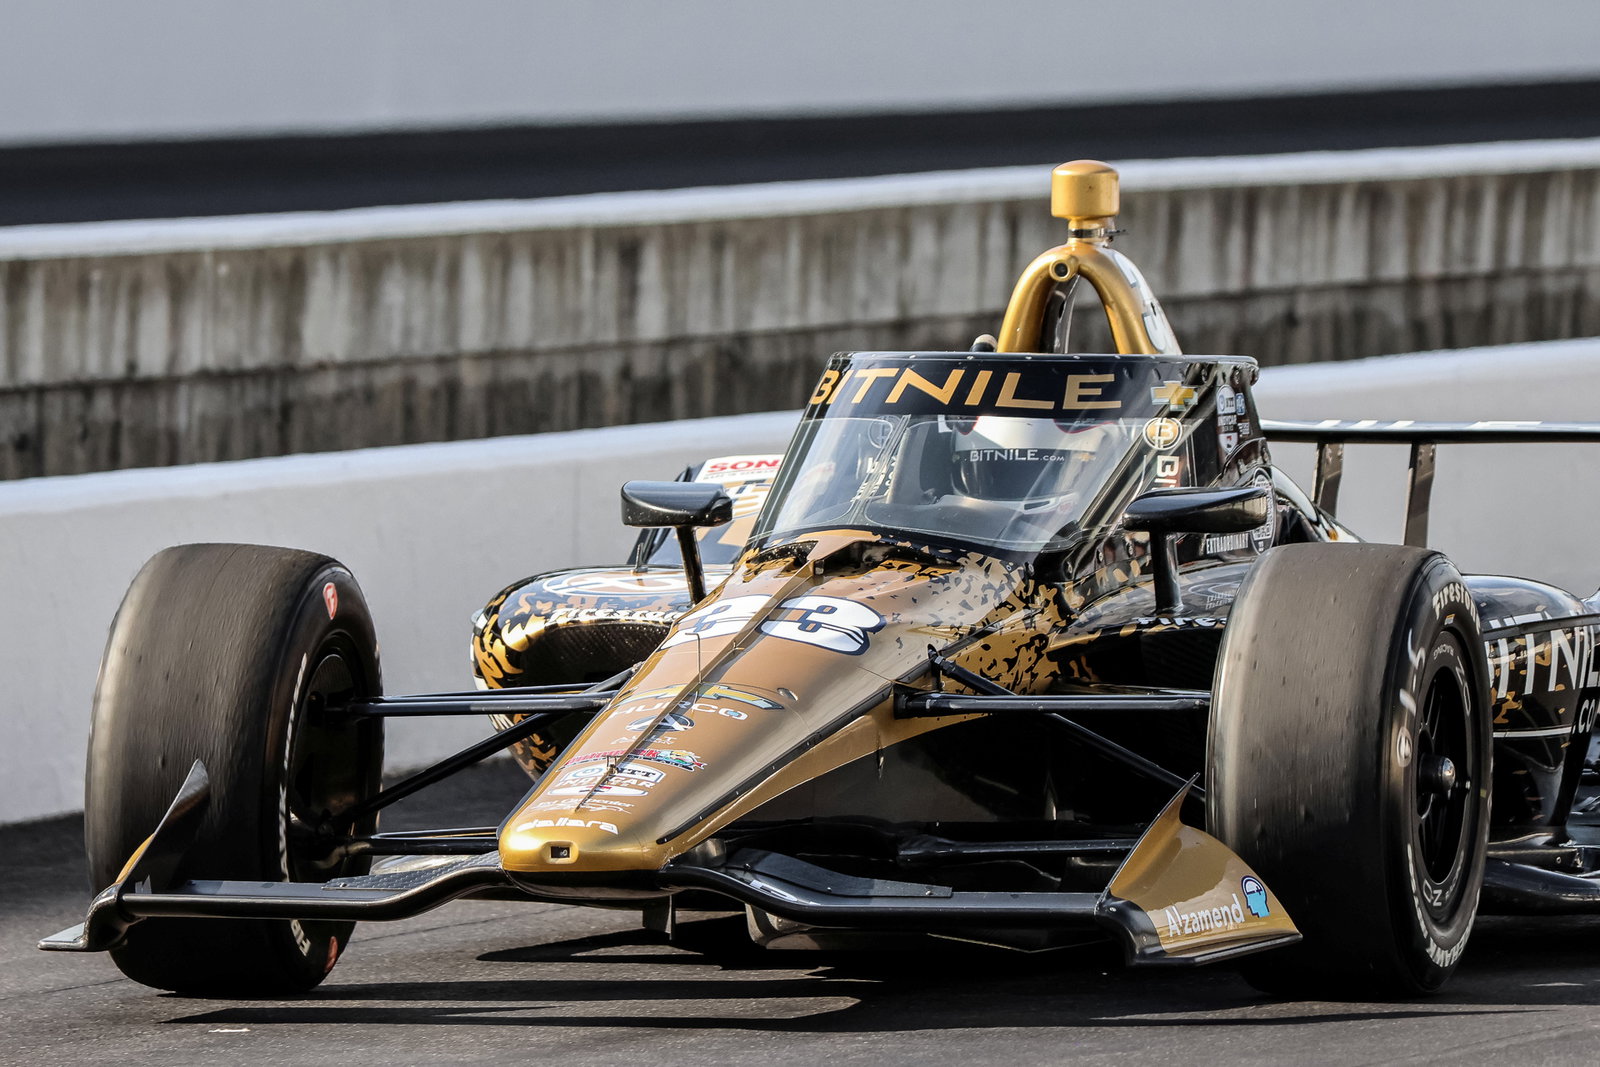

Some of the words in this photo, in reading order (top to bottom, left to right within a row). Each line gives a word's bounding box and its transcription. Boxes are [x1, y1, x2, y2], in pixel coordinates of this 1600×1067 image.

[809, 367, 1122, 410] BITNILE
[707, 459, 780, 473] SON
[1432, 582, 1481, 636] Firestone
[516, 816, 619, 836] dallara
